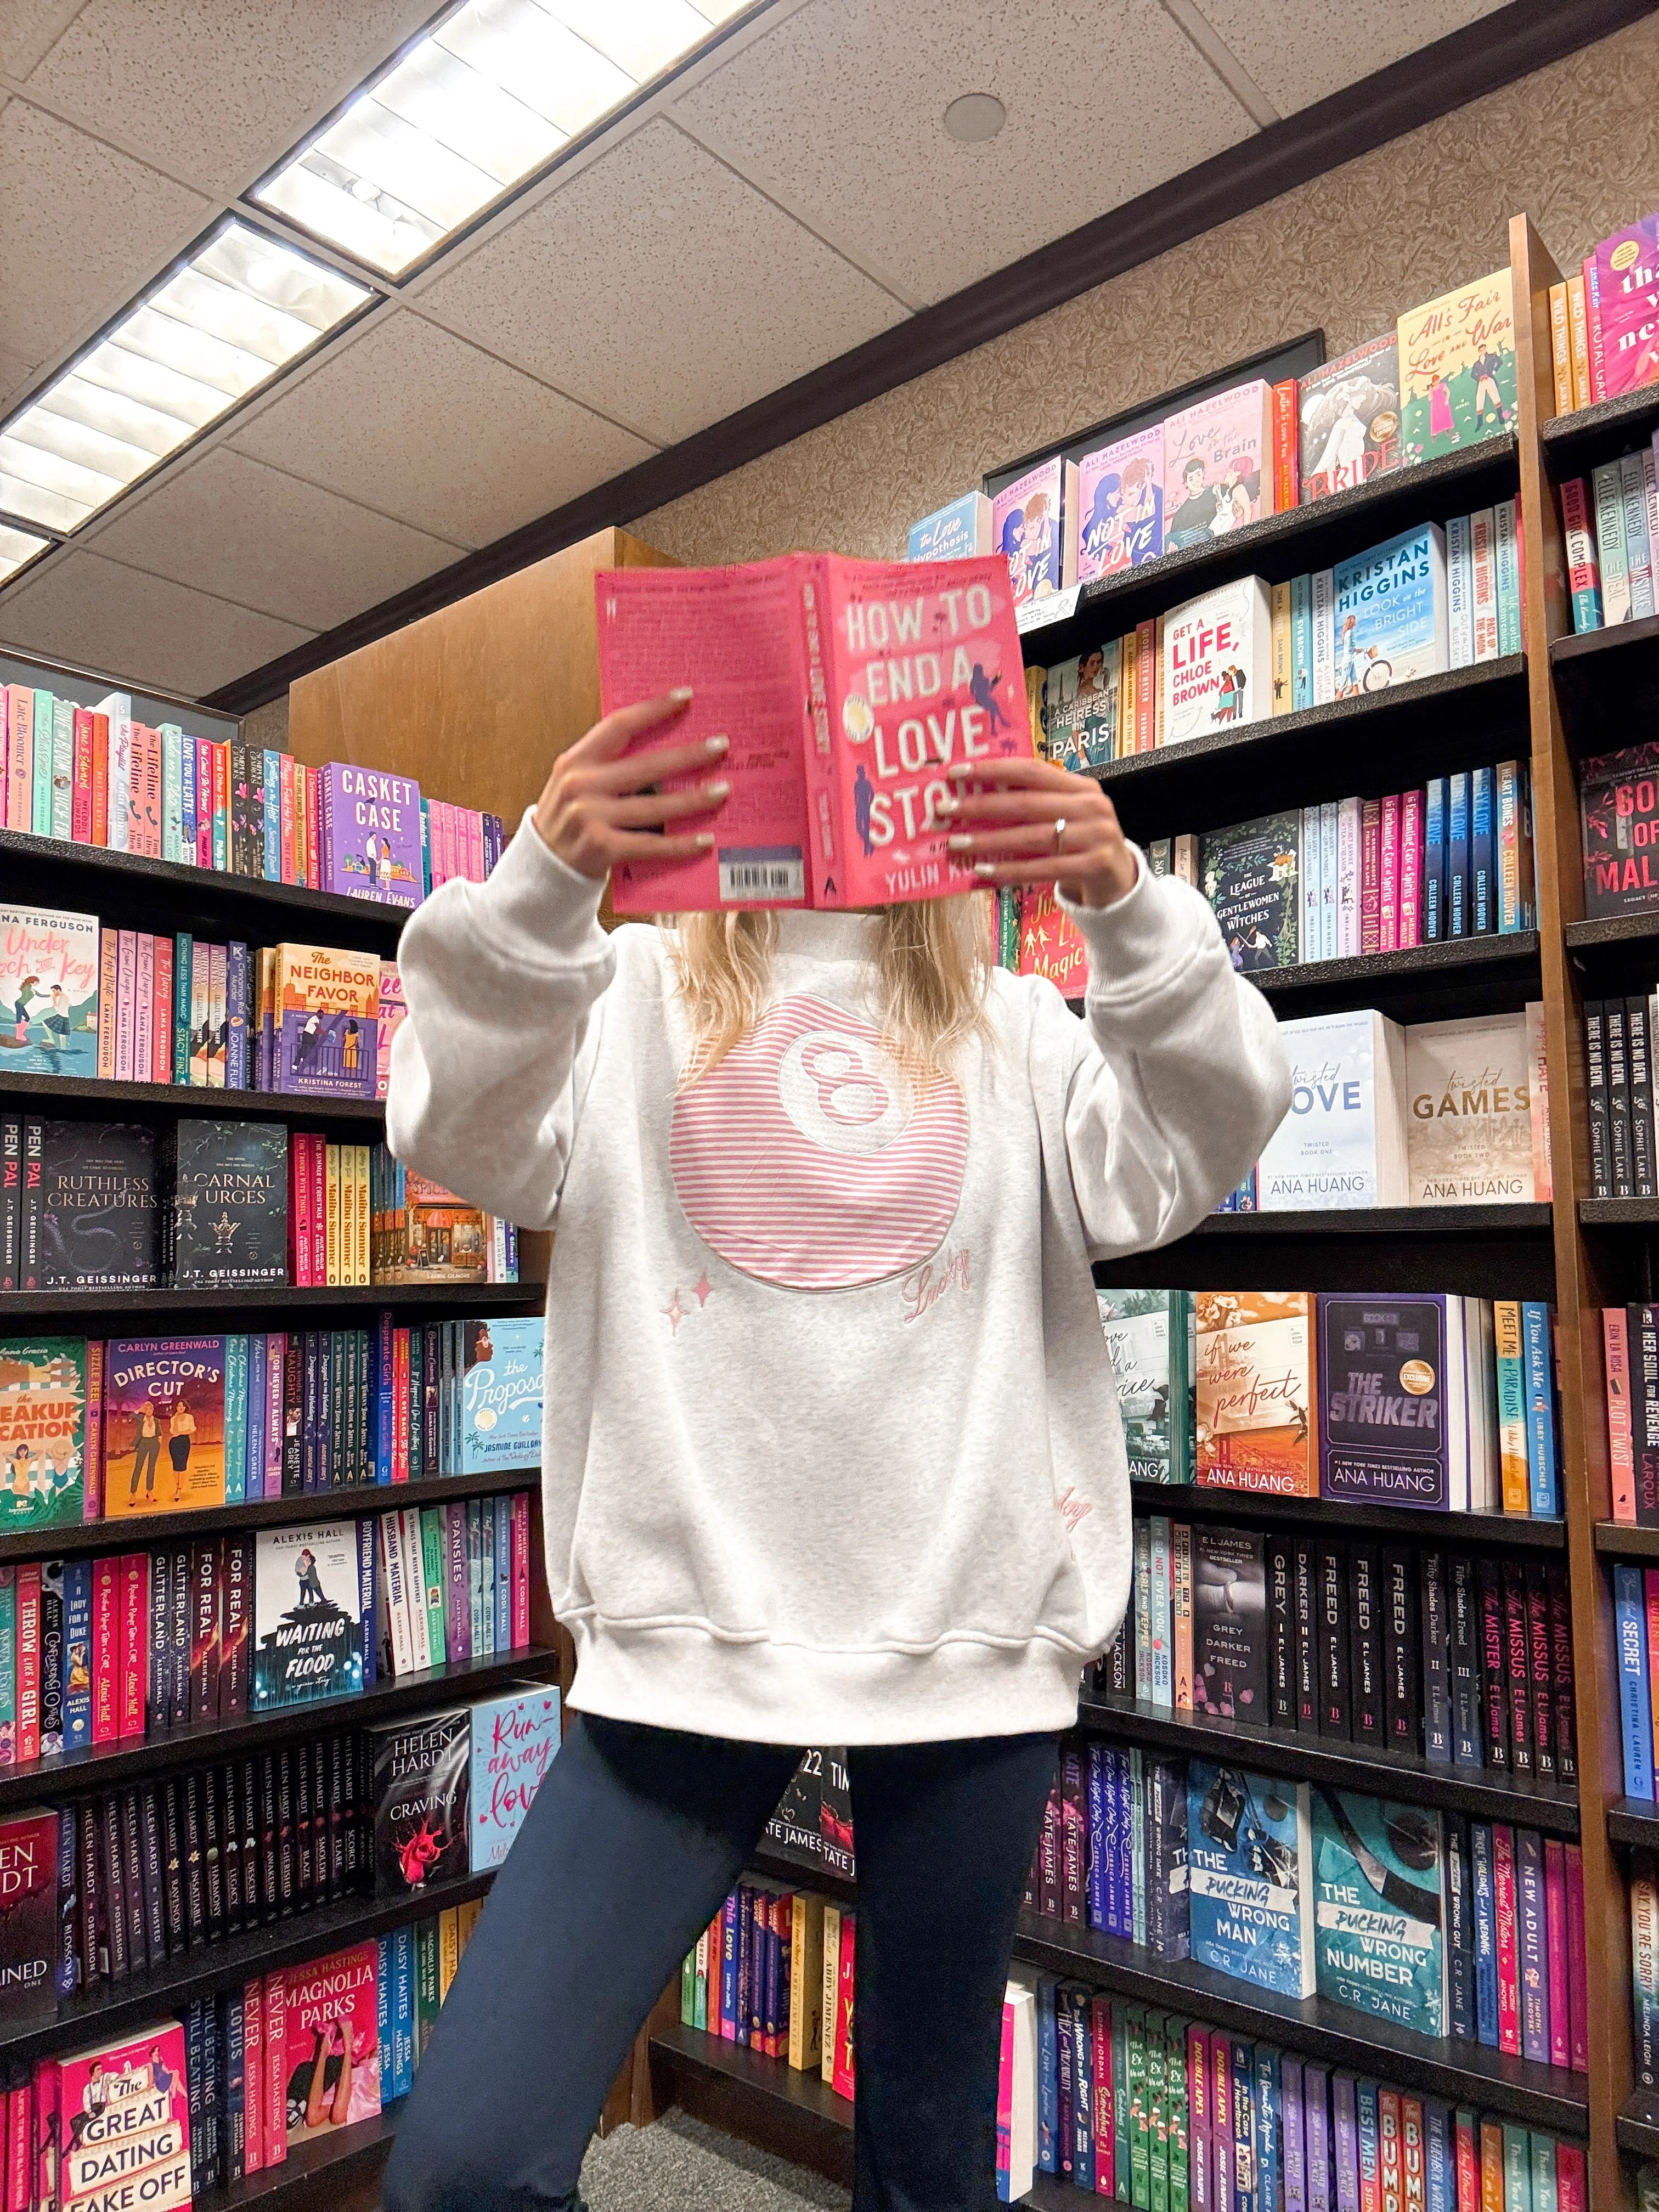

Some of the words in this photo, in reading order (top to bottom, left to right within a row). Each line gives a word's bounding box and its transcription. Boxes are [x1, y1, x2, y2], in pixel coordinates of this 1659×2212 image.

[1409, 308, 1452, 346] All's
[1458, 290, 1501, 323] Fair
[1405, 350, 1445, 381] Love
[1450, 341, 1467, 354] AND
[1466, 311, 1511, 344] War
[1441, 335, 1451, 343] IN
[1085, 459, 1098, 469] ALI
[1102, 428, 1161, 460] HAZELWOOD
[1170, 427, 1220, 467] Love
[1214, 439, 1256, 463] Brain
[1300, 437, 1399, 501] BRIDE
[1086, 515, 1124, 551] NOT
[1135, 503, 1155, 523] IN
[1599, 504, 1618, 551] KENNEDY
[1098, 520, 1154, 575] LOVE
[1338, 540, 1429, 594] KRISTAN
[1571, 540, 1587, 588] COMPLEX
[1339, 561, 1430, 613] HIGGINS
[1364, 595, 1399, 617] LOOK
[1414, 588, 1426, 599] the
[1375, 601, 1423, 629] BRIGHT
[847, 597, 923, 651] HOW
[942, 584, 991, 635] TO
[1173, 624, 1192, 641] GET
[1196, 619, 1204, 629] A
[1398, 618, 1429, 637] SIDE
[866, 653, 942, 706] END
[951, 646, 974, 691] A
[1173, 661, 1212, 688] CHLOE
[1062, 688, 1109, 712] CARIBBEAN
[1173, 675, 1220, 707] BROWN
[17, 699, 28, 720] Late
[1056, 701, 1107, 729] HEIRESS
[1076, 722, 1085, 731] IN
[16, 722, 27, 766] Bloomer
[874, 705, 989, 778] LOVE
[1052, 724, 1110, 759] PARIS
[130, 743, 142, 793] Lifeline
[1502, 768, 1511, 794] HEART
[342, 770, 411, 805] CASKET
[356, 802, 402, 832] CASE
[1503, 797, 1513, 827] BONES
[885, 865, 939, 896] YULIN
[1503, 850, 1514, 885] COLLEEN
[346, 886, 382, 903] LAUREN
[386, 891, 415, 908] EVANS
[1230, 876, 1265, 896] LEAGUE
[1216, 891, 1279, 920] GENTLEWOMEN
[1504, 887, 1514, 926] HOOVER
[25, 917, 93, 933] FERGUSON
[1227, 910, 1269, 931] WITCHES
[6, 928, 70, 955] Under
[59, 952, 95, 988] Key
[311, 952, 331, 964] The
[1033, 947, 1083, 985] Magic
[291, 966, 375, 987] NEIGHBOR
[307, 985, 358, 1002] FAVOR
[177, 1028, 185, 1051] STACY
[1588, 1017, 1601, 1040] THERE
[1589, 1042, 1601, 1051] IS
[1590, 1053, 1601, 1067] NO
[1447, 1067, 1503, 1095] twisted
[1590, 1068, 1602, 1087] DEVIL
[1292, 1081, 1361, 1115] OVE
[1413, 1086, 1531, 1119] GAMES
[4, 1124, 18, 1155] PEN
[1592, 1121, 1601, 1153] SOPHIE
[4, 1161, 16, 1188] PAL
[58, 1176, 149, 1191] RUTHLESS
[194, 1173, 274, 1188] CARNAL
[1594, 1158, 1602, 1180] LARK
[48, 1193, 157, 1207] CREATURES
[205, 1190, 266, 1204] URGES
[329, 1183, 337, 1217] Malibu
[1272, 1180, 1304, 1195] ANA
[1308, 1176, 1364, 1193] HUANG
[1423, 1183, 1457, 1199] ANA
[1463, 1179, 1523, 1197] HUANG
[329, 1220, 337, 1268] Summer
[47, 1277, 70, 1285] J.T.
[76, 1275, 156, 1283] GEISSINGER
[900, 1249, 969, 1324] Lucky
[1528, 1310, 1540, 1321] If
[118, 1342, 159, 1353] CARLYN
[160, 1340, 219, 1351] GREENWALD
[1530, 1323, 1541, 1342] You
[1643, 1332, 1656, 1352] HER
[1205, 1334, 1221, 1364] if
[1228, 1341, 1256, 1353] we
[1532, 1345, 1542, 1364] Ask
[114, 1361, 220, 1387] DIRECTOR'S
[1209, 1365, 1255, 1386] were
[1533, 1367, 1544, 1388] Me
[1643, 1352, 1656, 1383] SOUL
[148, 1381, 184, 1397] CUT
[1347, 1372, 1384, 1394] THE
[1645, 1385, 1656, 1398] FOR
[1214, 1369, 1302, 1430] perfect
[1329, 1393, 1438, 1429] STRIKER
[1611, 1400, 1626, 1426] PLOT
[1645, 1400, 1658, 1447] REVENGE
[1612, 1433, 1629, 1468] TWIST
[1206, 1469, 1235, 1486] ANA
[1238, 1472, 1294, 1493] HUANG
[1334, 1468, 1367, 1485] ANA
[1374, 1472, 1435, 1493] HUANG
[273, 1532, 313, 1545] ALEXIS
[318, 1529, 344, 1539] HALL
[362, 1520, 372, 1567] BOYFRIEND
[452, 1519, 462, 1583] PANSIES
[201, 1554, 212, 1588] FOR
[155, 1556, 165, 1649] GLITTERLAND
[362, 1568, 371, 1613] MATERIAL
[21, 1599, 37, 1652] THROW
[200, 1594, 211, 1639] REAL
[1212, 1624, 1243, 1635] GREY
[275, 1619, 345, 1647] WAITING
[1206, 1638, 1251, 1653] DARKER
[311, 1644, 323, 1652] THE
[1210, 1655, 1246, 1668] FREED
[1623, 1621, 1640, 1676] SECRET
[24, 1657, 33, 1677] LIKE
[285, 1655, 334, 1678] FLOOD
[21, 1690, 36, 1730] GIRL
[394, 1728, 453, 1757] HELEN
[393, 1750, 453, 1776] HARDT
[390, 1791, 456, 1820] CRAVING
[1193, 1849, 1227, 1871] THE
[1525, 1865, 1535, 1901] NEW
[1216, 1918, 1257, 1945] MAN
[1227, 1903, 1289, 1932] WRONG
[87, 1916, 96, 1971] OBSESSION
[1525, 1909, 1537, 1961] ADULT
[1241, 1962, 1276, 1984] JANE
[1327, 1948, 1413, 1987] NUMBER
[286, 1965, 375, 2010] MAGNOLIA
[269, 1975, 284, 2042] NEVER
[300, 1994, 355, 2030] PARKS
[114, 2079, 142, 2096] The
[86, 2097, 166, 2141] GREAT
[1359, 2095, 1373, 2140] BEST
[81, 2134, 173, 2183] DATING
[1360, 2140, 1375, 2182] MEN
[139, 2165, 185, 2200] OFF
